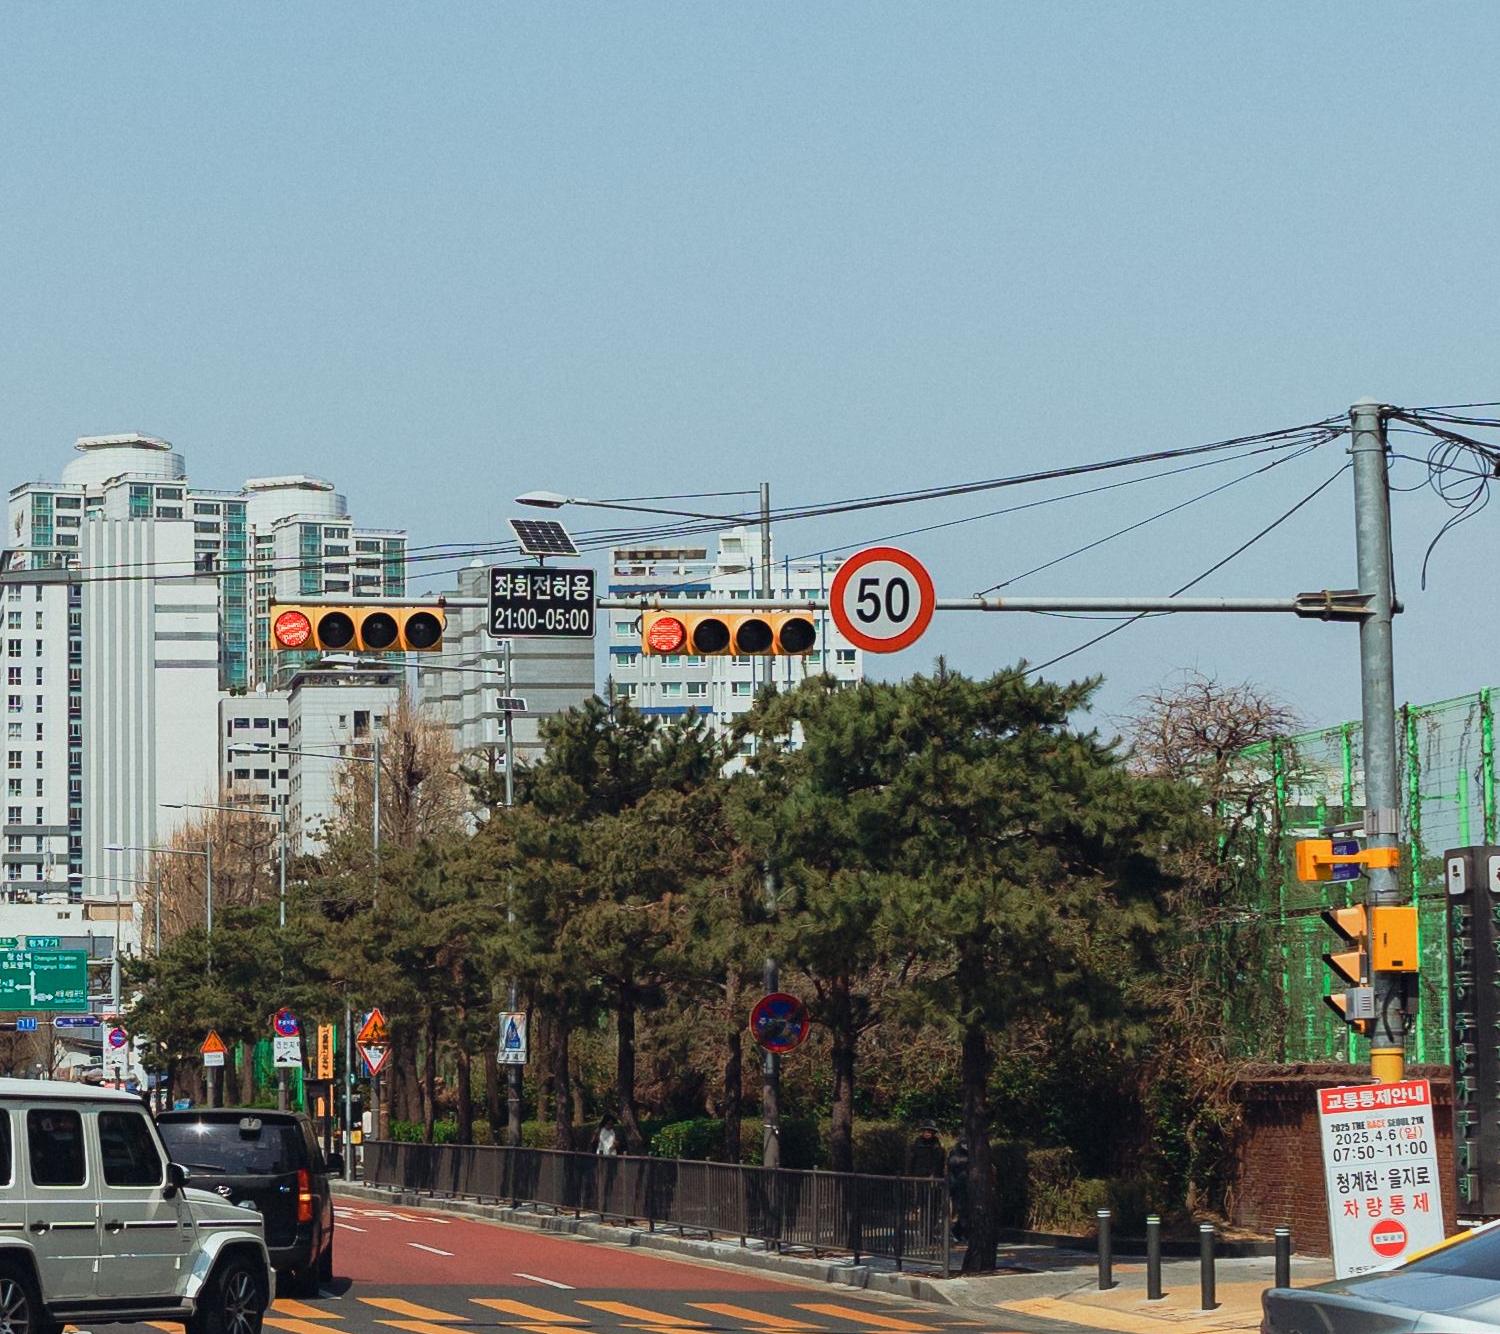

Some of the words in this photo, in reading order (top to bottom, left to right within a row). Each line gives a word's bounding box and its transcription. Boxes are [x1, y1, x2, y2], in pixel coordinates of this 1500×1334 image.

[494, 573, 591, 601] 좌회전허용
[856, 577, 910, 624] 50
[494, 607, 590, 630] 21:00-05:00
[1326, 1085, 1425, 1110] 교통통제안내
[1335, 1129, 1397, 1146] 2025.4.6
[1333, 1140, 1428, 1163] 07:50~11:00
